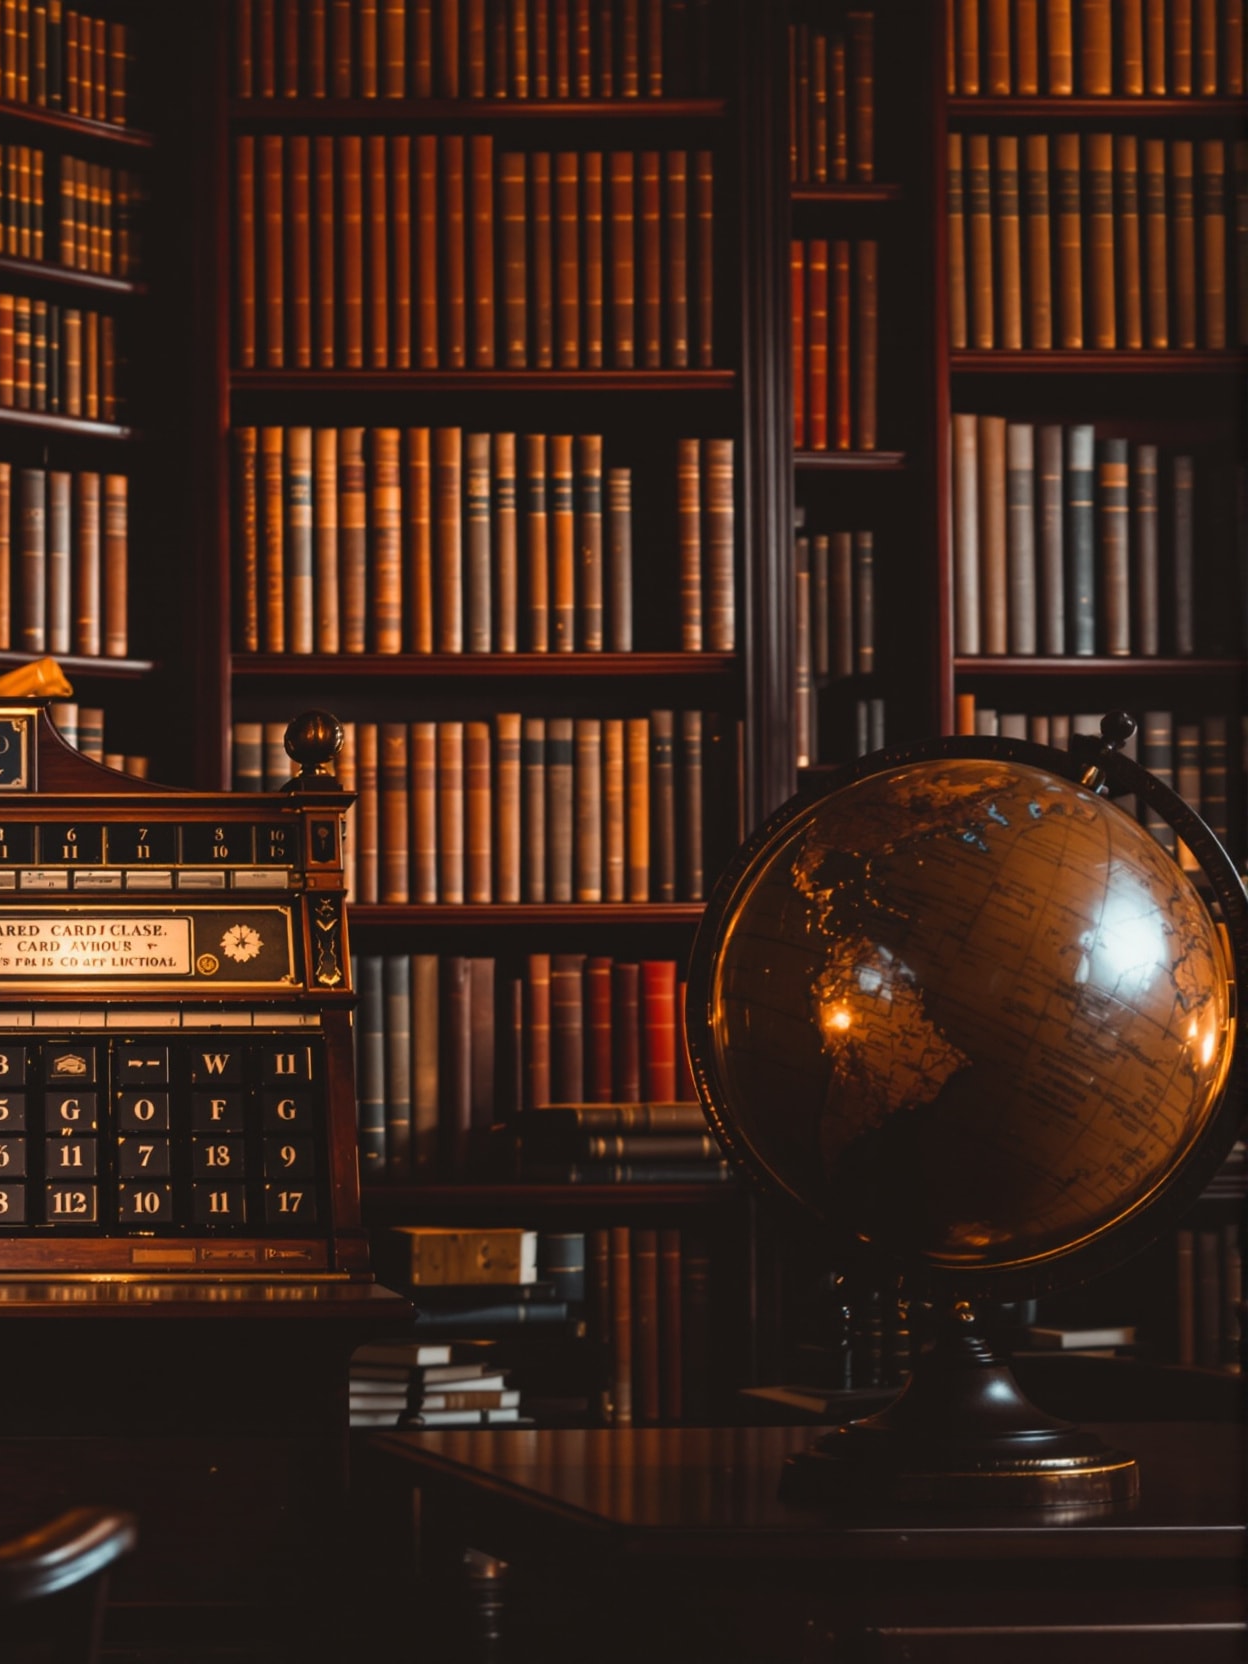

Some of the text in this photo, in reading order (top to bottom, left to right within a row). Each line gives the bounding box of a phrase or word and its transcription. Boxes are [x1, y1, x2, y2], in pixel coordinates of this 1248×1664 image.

[139, 829, 148, 840] 7
[64, 846, 77, 858] 11
[138, 846, 149, 858] 11
[17, 940, 61, 952] CARD
[203, 1055, 229, 1073] W
[61, 1100, 80, 1120] G
[212, 1100, 226, 1119] F
[278, 1100, 295, 1119] G
[61, 1146, 82, 1166] 11
[139, 1146, 153, 1166] 7
[207, 1146, 230, 1165] 18
[281, 1147, 295, 1166] 9
[134, 1192, 159, 1213] 10
[210, 1192, 228, 1212] 11
[279, 1192, 302, 1212] 17
